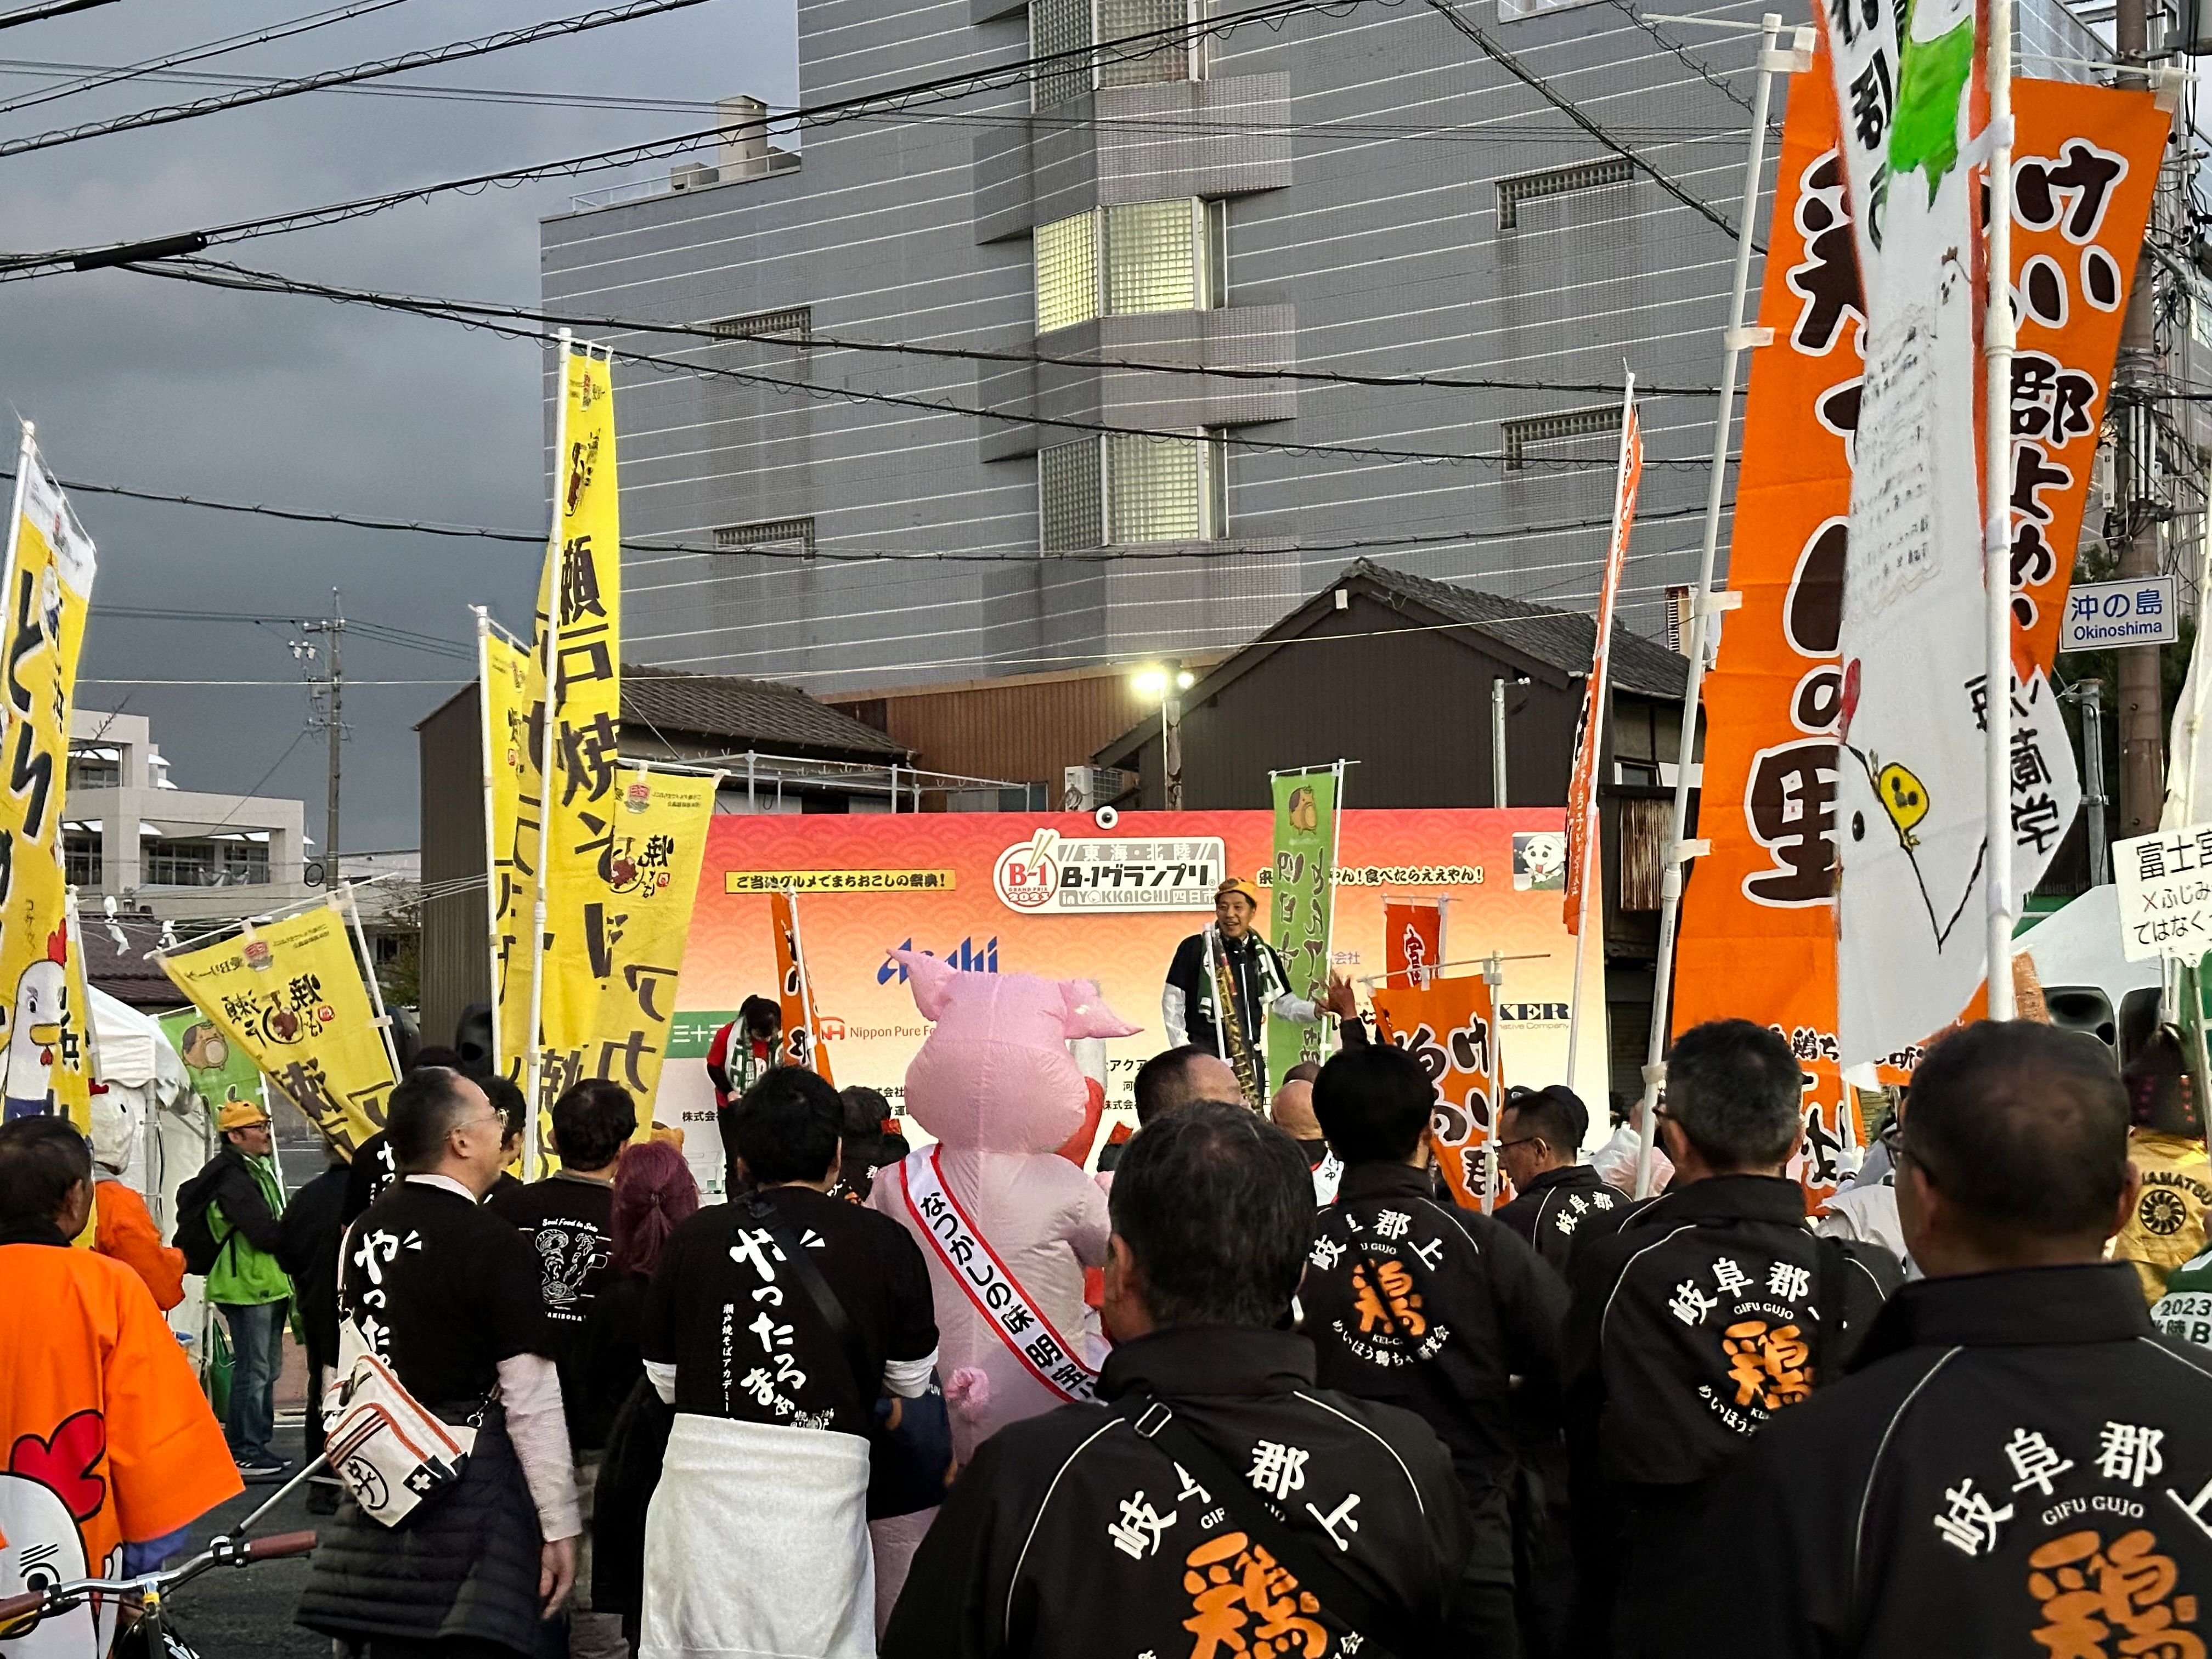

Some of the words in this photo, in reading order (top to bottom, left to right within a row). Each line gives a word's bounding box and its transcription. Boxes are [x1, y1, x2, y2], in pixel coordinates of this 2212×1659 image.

[2071, 589, 2163, 621] 沖の島
[2074, 621, 2163, 640] Okinoshima
[1008, 862, 1047, 886] B-1
[1060, 864, 1209, 887] B-1グランプリ
[850, 1026, 892, 1040] Nippon
[894, 1025, 921, 1037] Pure
[682, 1110, 719, 1122] 株式会
[920, 1192, 1035, 1335] なつかしの味
[1734, 1301, 1760, 1316] GIFU
[1763, 1302, 1794, 1320] GUJO
[2042, 1497, 2087, 1526] GIFU
[2091, 1495, 2146, 1520] GUJO
